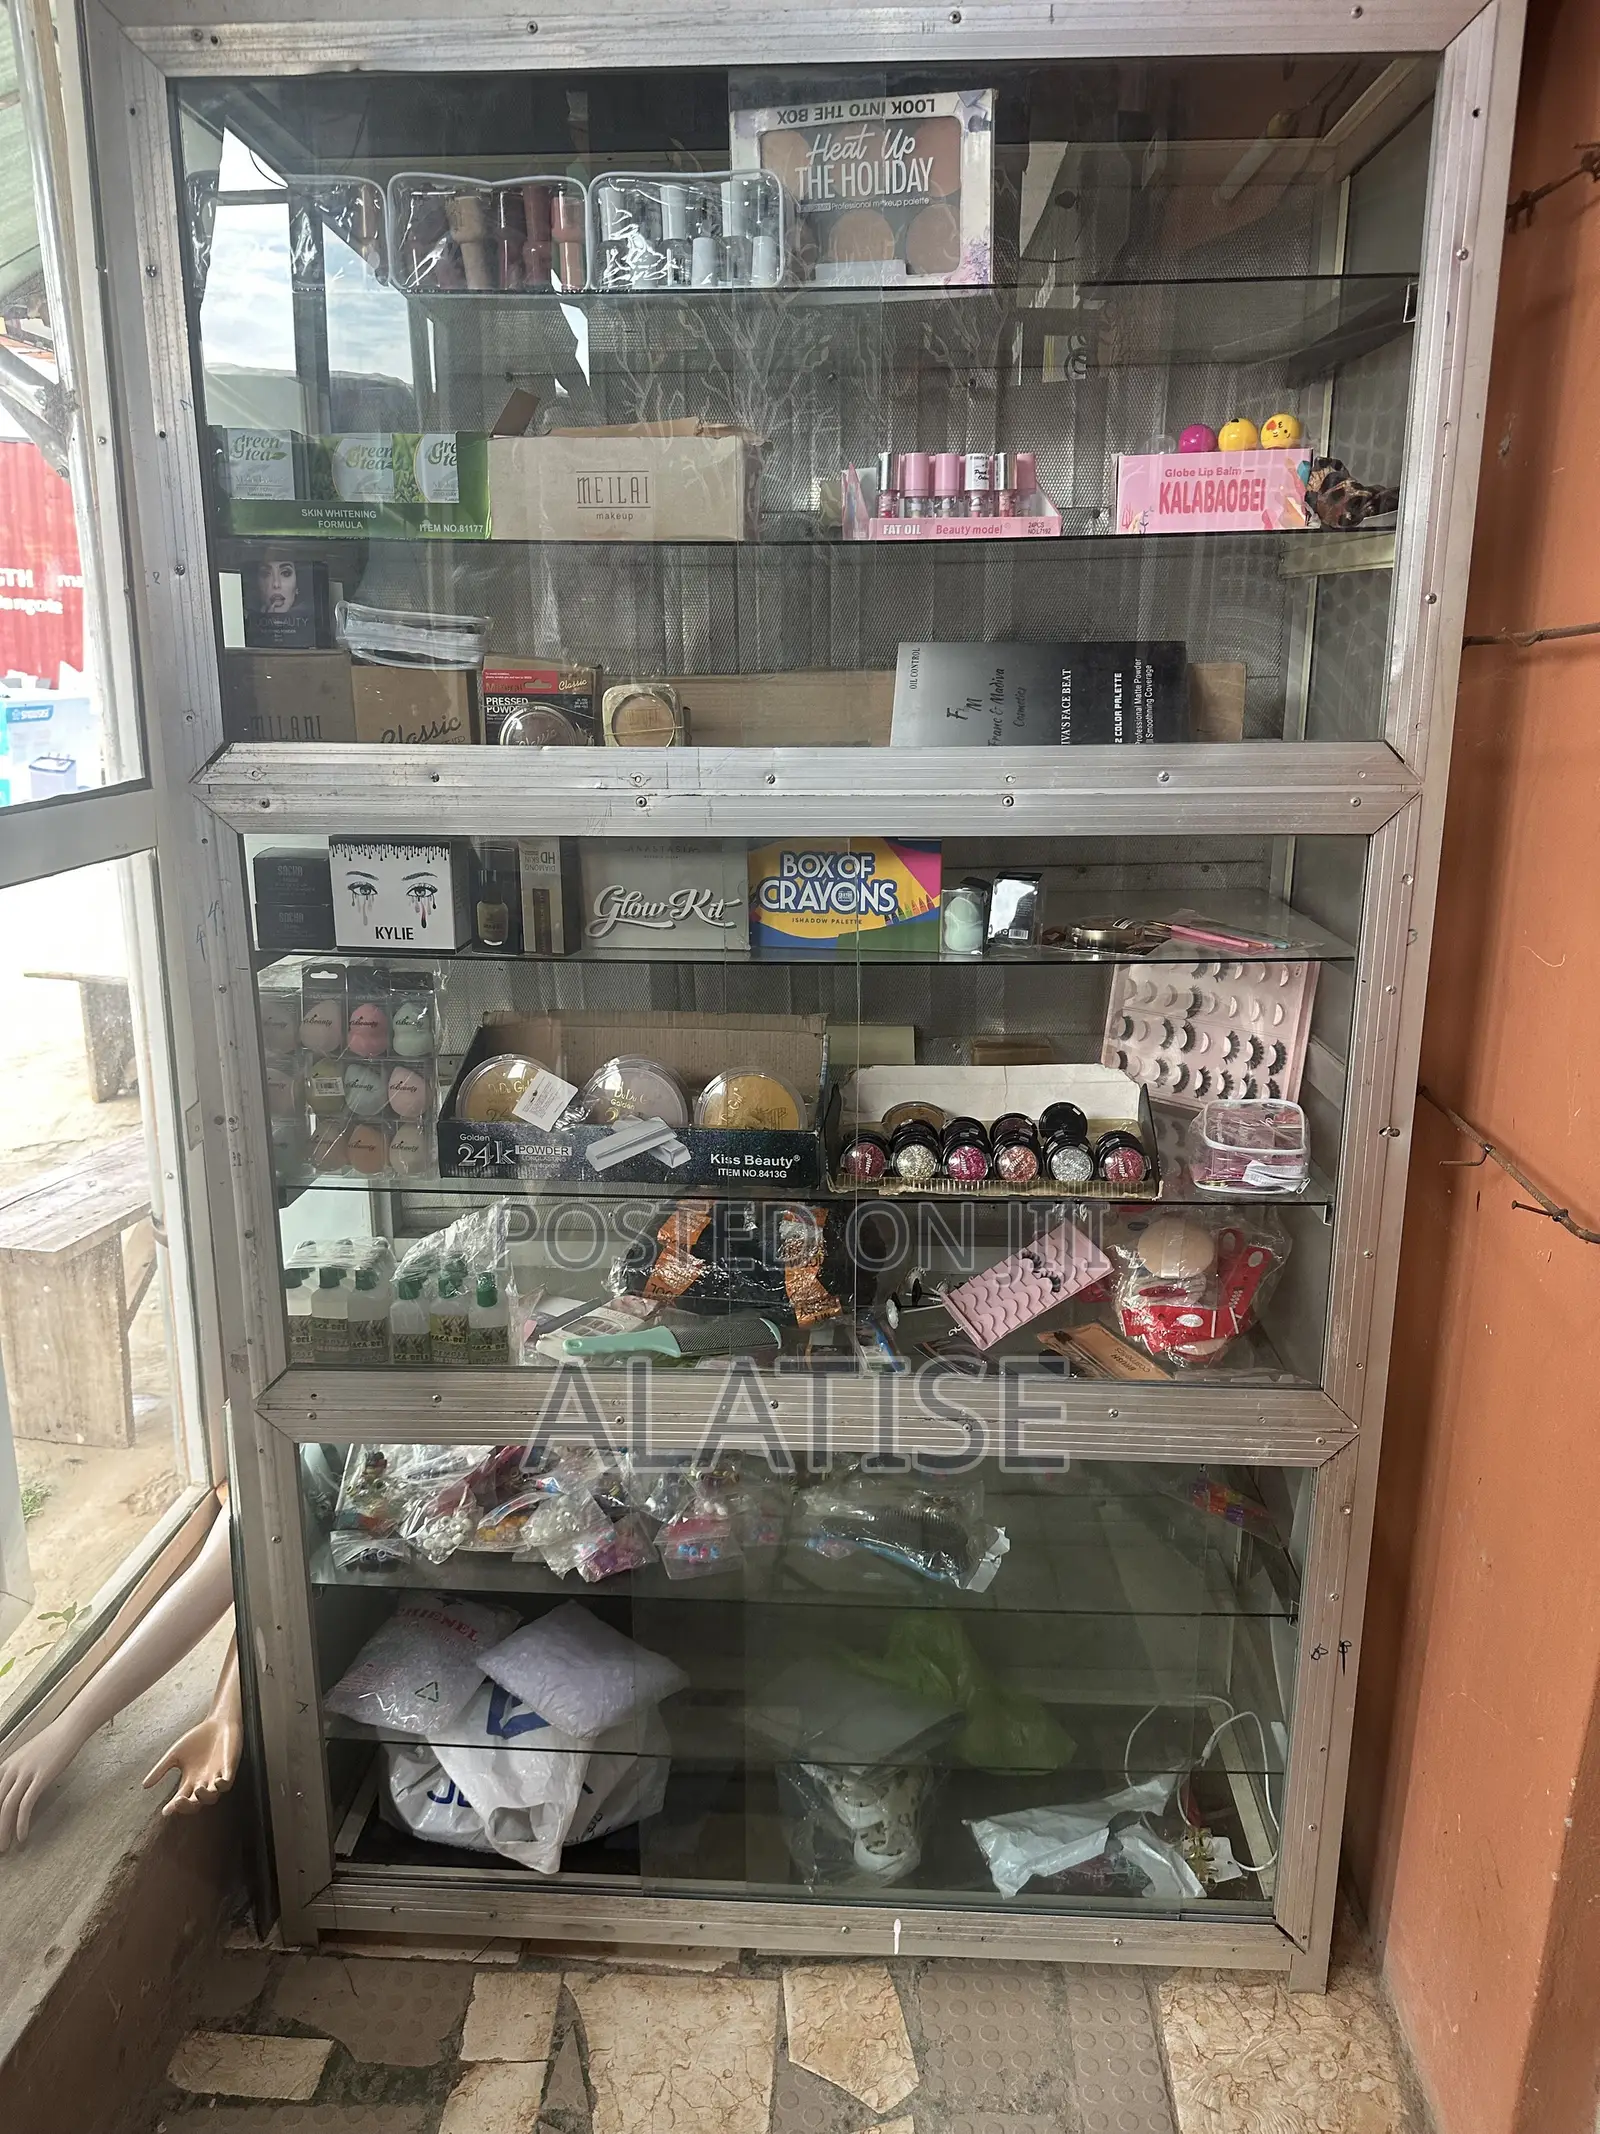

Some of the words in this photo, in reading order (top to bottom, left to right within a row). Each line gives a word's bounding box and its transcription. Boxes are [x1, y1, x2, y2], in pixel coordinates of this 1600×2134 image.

[814, 105, 843, 120] THE
[850, 101, 885, 116] INTO
[892, 99, 935, 114] LOOK
[777, 108, 808, 125] BOX
[806, 124, 875, 165] Heat
[881, 128, 916, 166] Up
[794, 164, 835, 200] THE
[841, 157, 934, 197] HOLIDAY
[427, 440, 457, 464] Gre
[443, 454, 457, 466] te
[1165, 467, 1196, 478] Globe
[1198, 467, 1214, 477] Lip
[1216, 466, 1242, 476] Balm
[576, 476, 649, 504] MEILAI
[1159, 478, 1266, 515] KALABAOBEI
[301, 508, 323, 517] SKIN
[324, 509, 377, 519] WHITENING
[596, 512, 634, 521] makeup
[318, 520, 363, 529] FORMULA
[419, 524, 441, 532] ITEM
[443, 524, 484, 533] NO.81177
[883, 524, 902, 535] FAT
[904, 524, 922, 535] OIL
[936, 525, 970, 537] Beauty
[972, 524, 1003, 535] model
[910, 648, 920, 678] CONTROL
[1134, 658, 1142, 684] Powder
[558, 679, 588, 691] Classic
[909, 678, 918, 690] OIL
[1061, 668, 1071, 694] BEAT
[1144, 664, 1154, 698] Coverage
[1114, 673, 1123, 709] PALETTE
[1134, 685, 1142, 704] Matte
[486, 697, 529, 706] PRESSED
[1061, 696, 1071, 720] FACE
[486, 705, 521, 714] POWD
[380, 714, 462, 744] Classic
[1114, 710, 1123, 737] COLOR
[540, 851, 556, 864] HD
[783, 854, 834, 878] BOX
[837, 854, 873, 879] OF
[759, 879, 896, 912] CRAYONS
[585, 884, 675, 938] Glow
[668, 888, 743, 928] Kit
[375, 926, 414, 940] KYLIE
[460, 1133, 490, 1142] Golden
[457, 1140, 516, 1168] 24k
[519, 1145, 570, 1155] POWDER
[710, 1153, 741, 1165] Kiss
[718, 1168, 741, 1176] ITEM
[742, 1169, 787, 1178] NO.8413G
